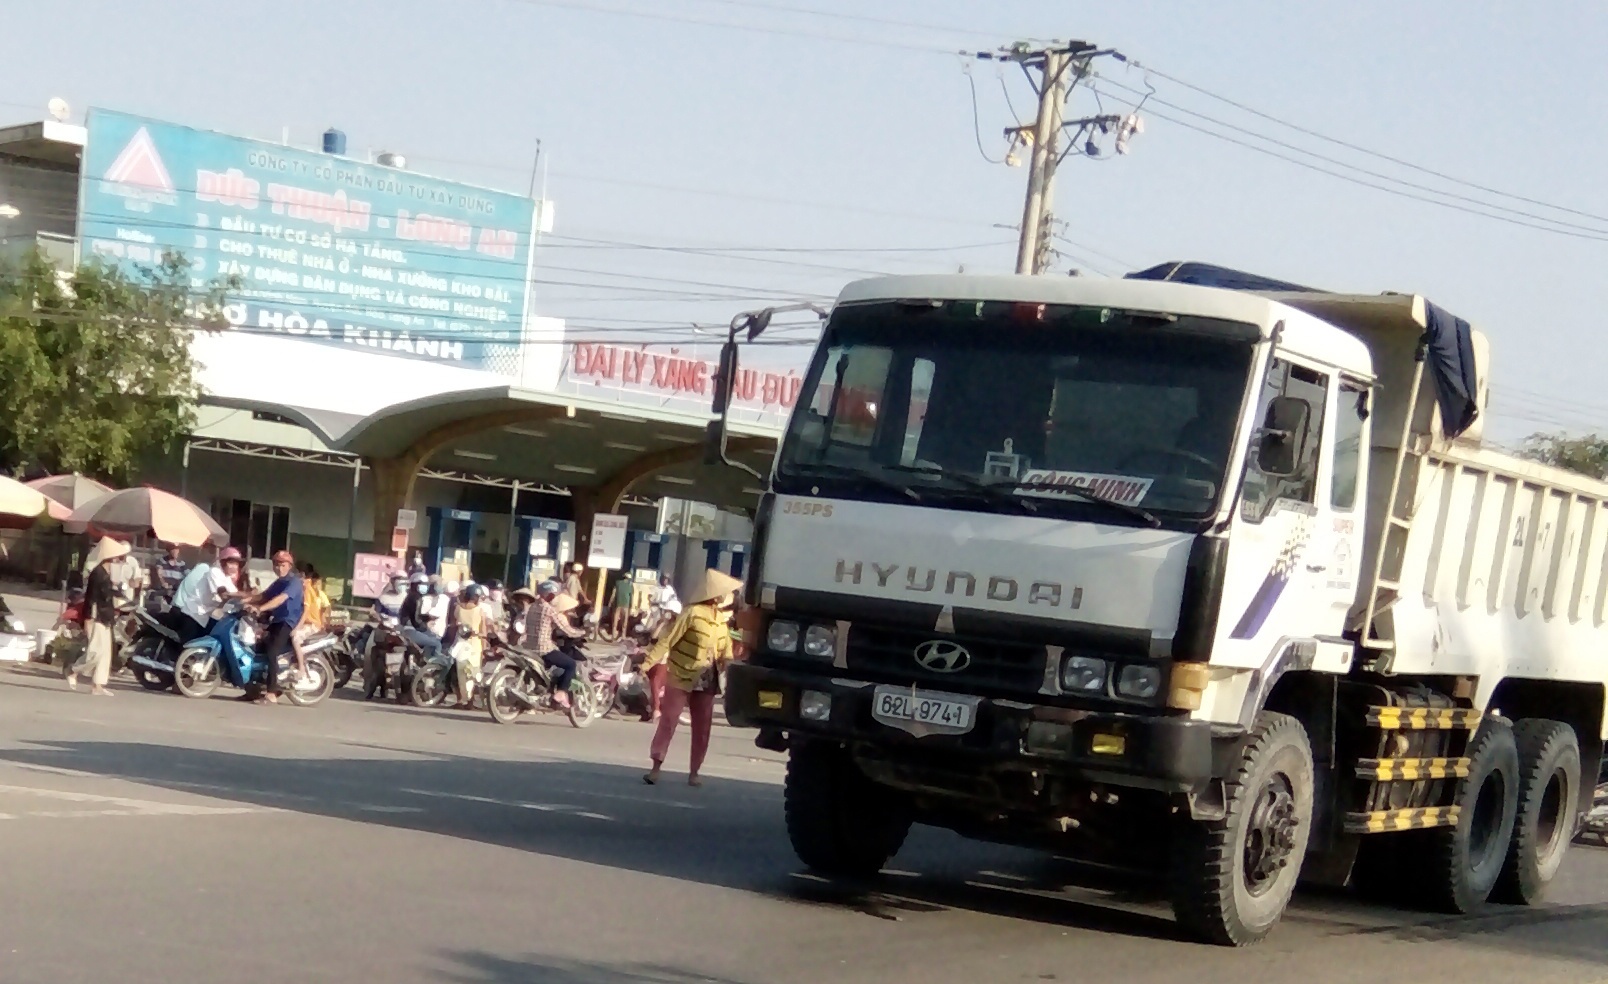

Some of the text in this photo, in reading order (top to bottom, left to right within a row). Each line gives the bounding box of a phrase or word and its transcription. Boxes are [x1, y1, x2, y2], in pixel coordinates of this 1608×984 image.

[292, 160, 307, 174] TY
[395, 208, 472, 250] LONG
[476, 228, 517, 260] AN
[219, 238, 254, 257] CHO
[451, 280, 482, 298] KHO
[344, 324, 463, 361] KHÁNH
[574, 342, 617, 387] ĐẠI
[622, 343, 648, 384] LÝ
[650, 347, 707, 395] XĂNG
[783, 501, 833, 518] 355PS
[834, 558, 1084, 610] HYUNDAI
